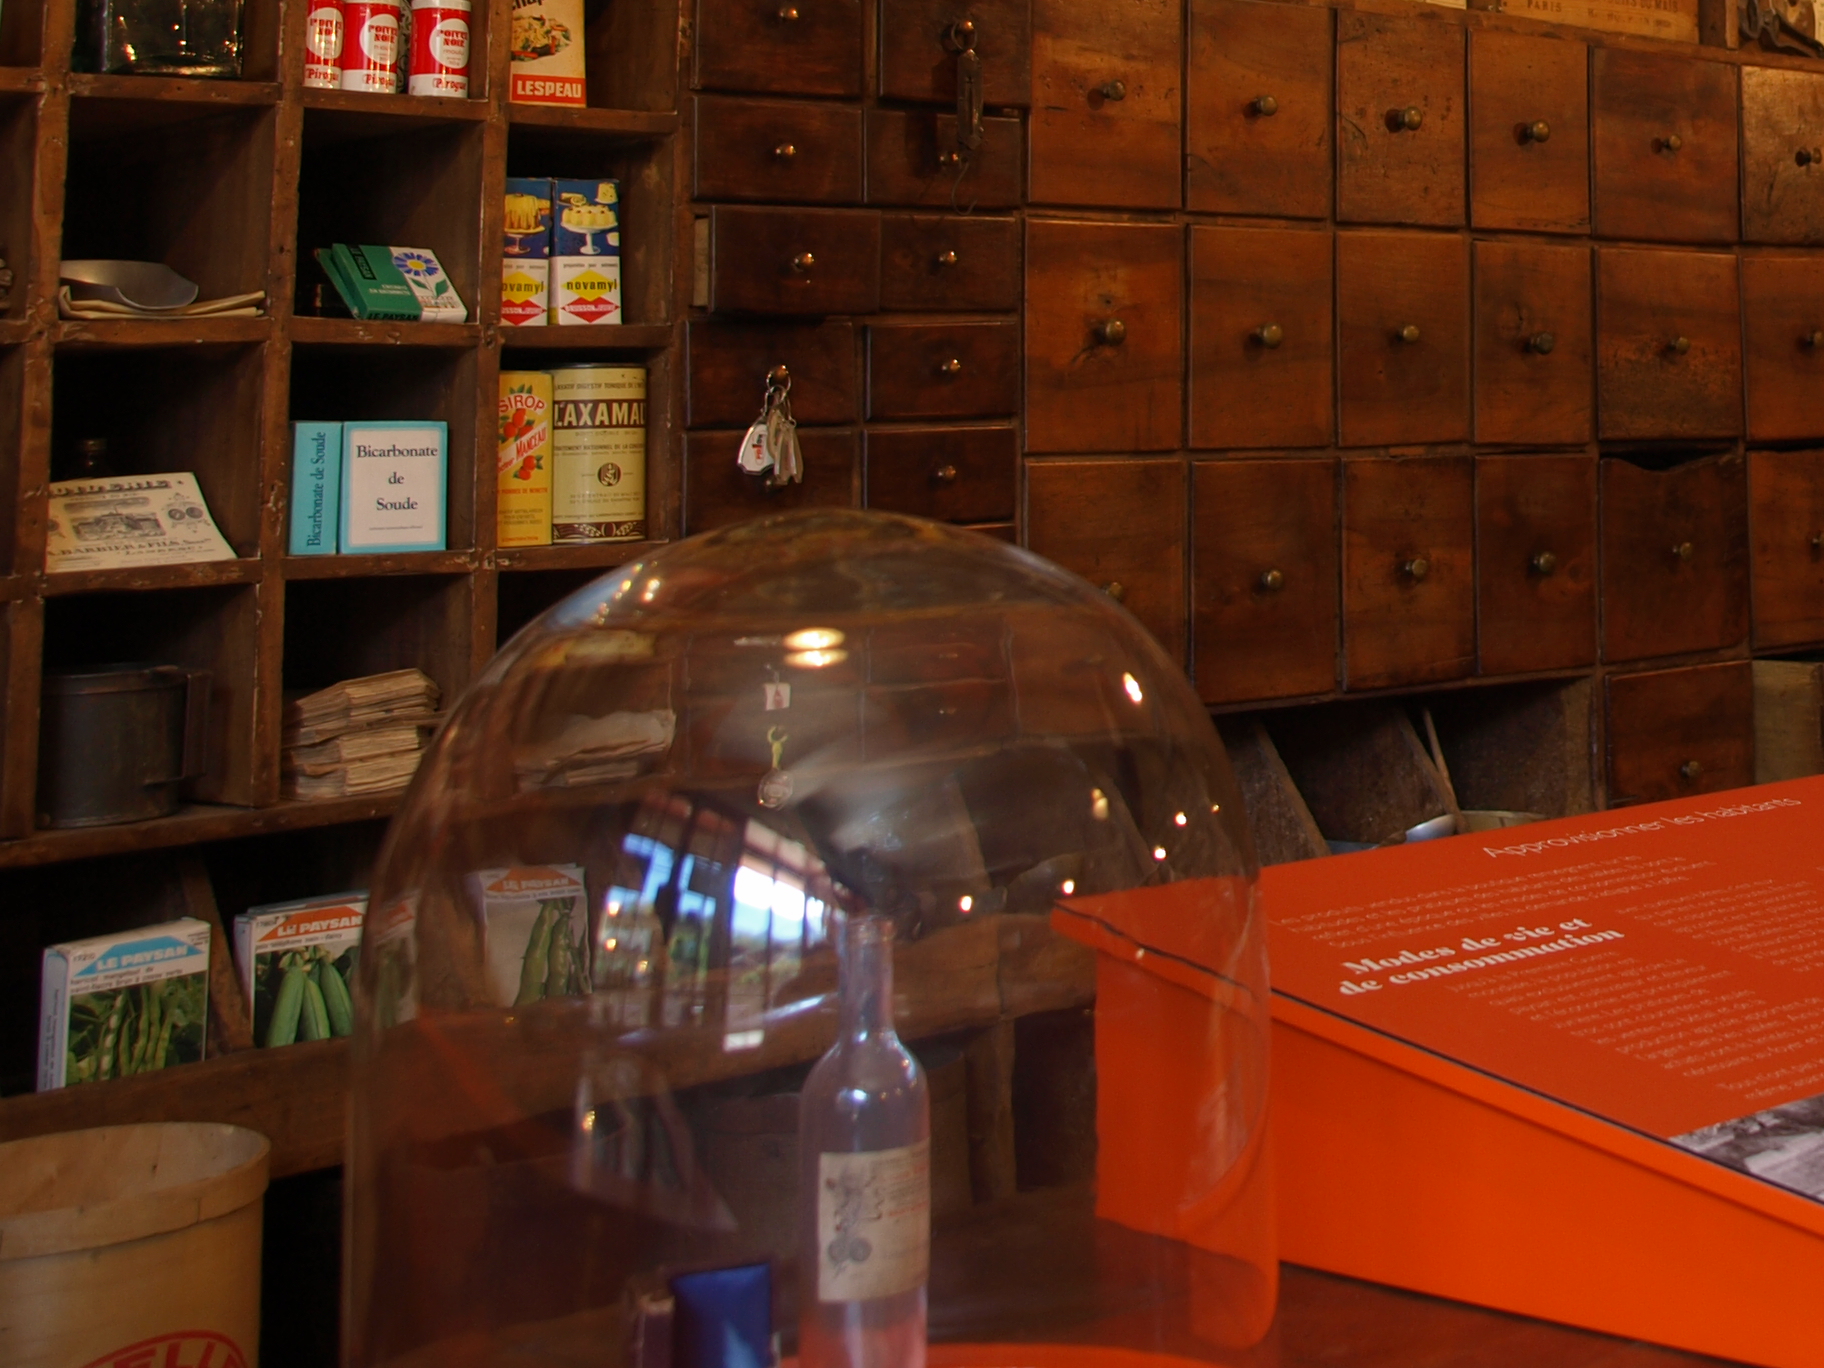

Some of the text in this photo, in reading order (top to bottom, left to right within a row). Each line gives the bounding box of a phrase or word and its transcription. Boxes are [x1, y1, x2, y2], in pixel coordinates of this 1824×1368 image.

[516, 80, 581, 98] LESPEAU
[566, 279, 617, 293] novamyl
[499, 394, 544, 412] SIROP
[355, 444, 438, 459] Bicarbonate
[516, 427, 547, 458] MANCEAU
[388, 472, 405, 485] de
[306, 431, 327, 548] Bicarbonate de Soude
[376, 497, 418, 512] Soude
[1482, 795, 1803, 859] Approvisionner les habitants
[299, 916, 363, 932] PAYSAN
[1340, 916, 1593, 976] Modes de vie et
[96, 945, 187, 970] LE PAYSAN
[1338, 928, 1625, 996] de consommation
